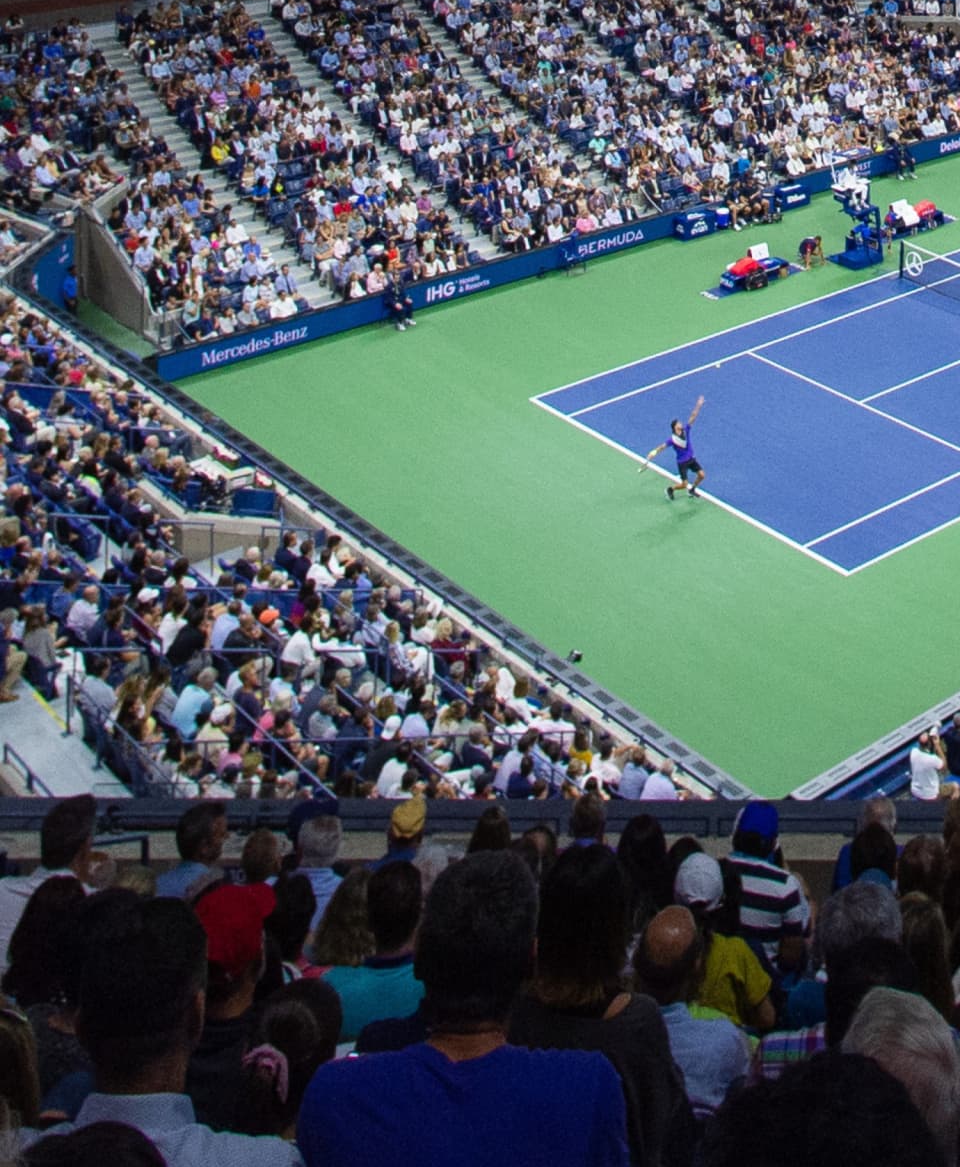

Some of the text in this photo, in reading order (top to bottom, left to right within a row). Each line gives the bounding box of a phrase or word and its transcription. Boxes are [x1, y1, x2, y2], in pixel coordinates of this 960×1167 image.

[578, 229, 644, 254] BERMUDA
[459, 274, 481, 285] Hotels
[465, 279, 490, 291] Resorts
[426, 281, 456, 302] IHG
[202, 326, 308, 366] Mercedes-Benz
